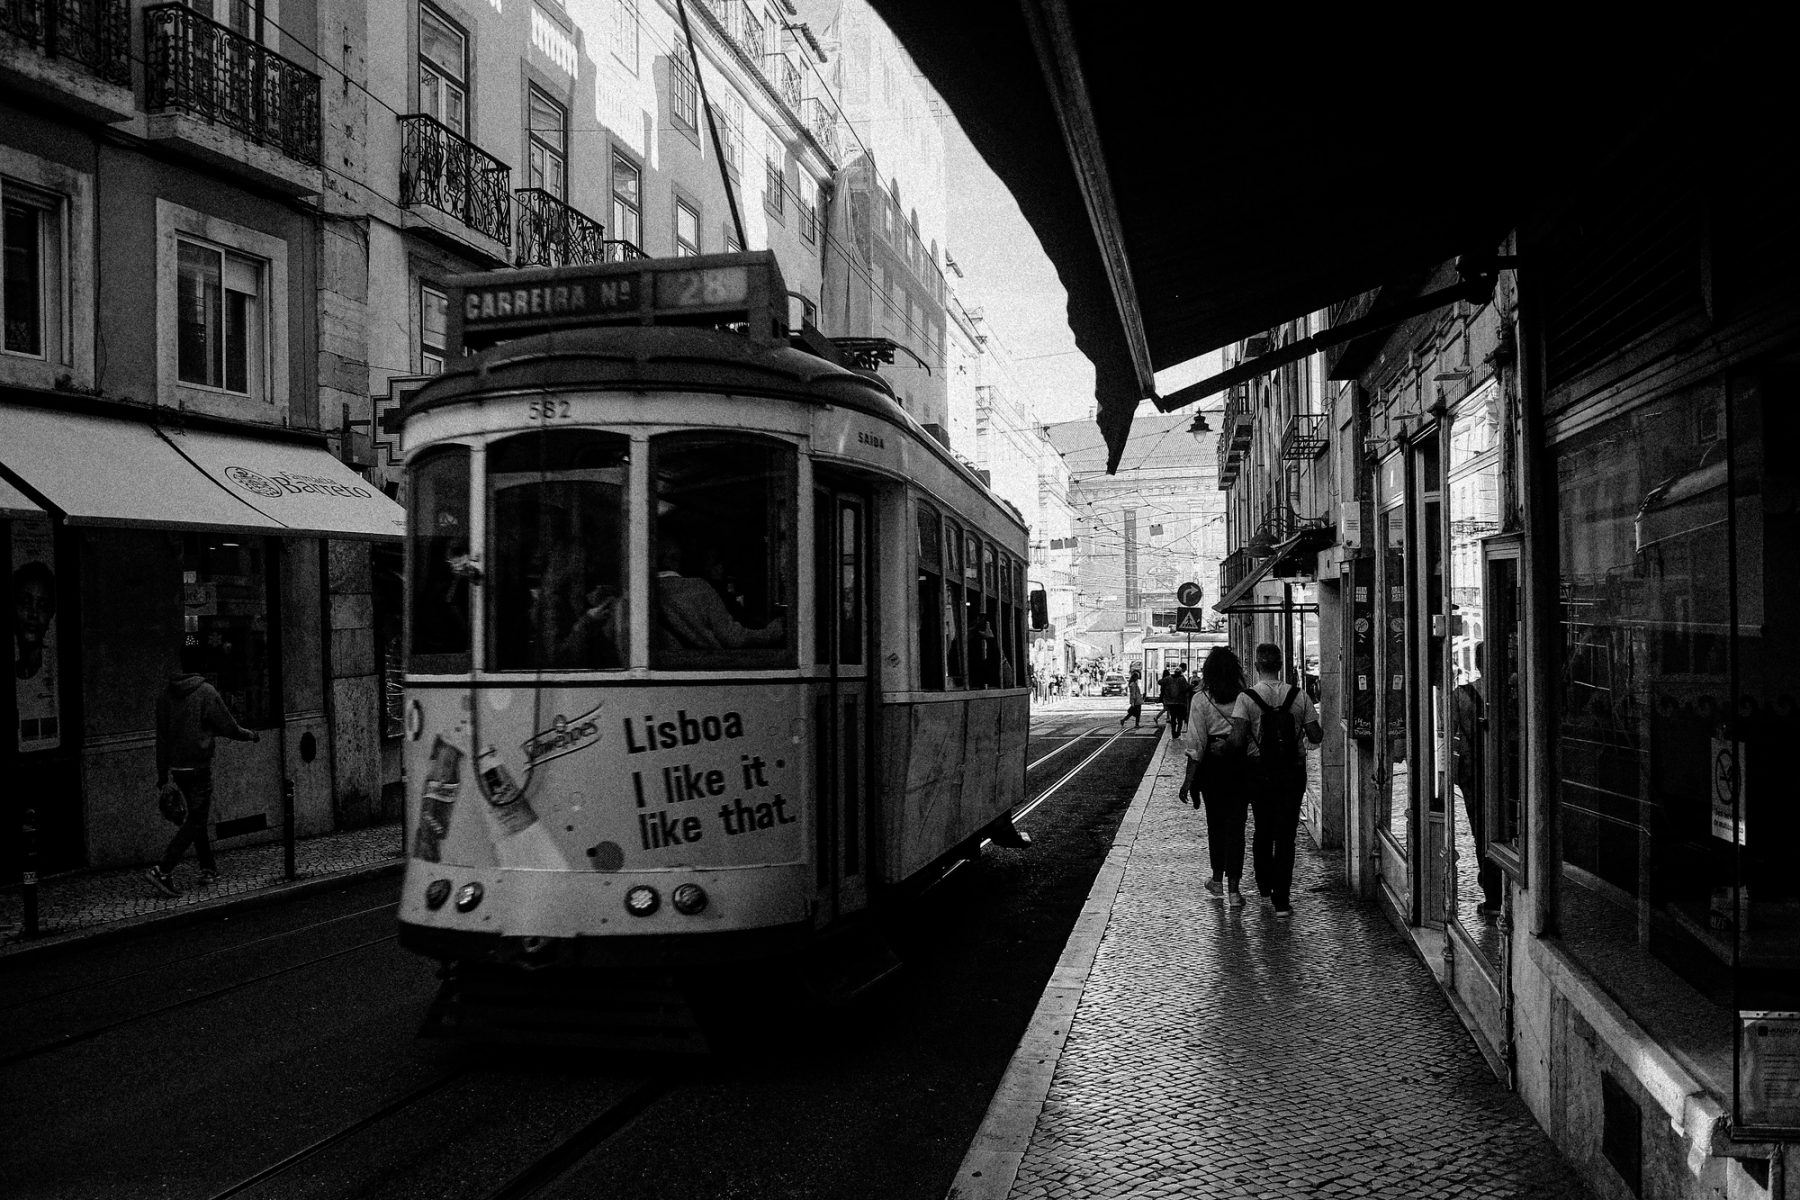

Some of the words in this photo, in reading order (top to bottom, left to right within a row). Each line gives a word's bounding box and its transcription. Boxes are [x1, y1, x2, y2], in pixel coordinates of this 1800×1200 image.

[465, 285, 586, 320] CARREIRA
[678, 270, 726, 306] 28
[271, 477, 372, 498] Barreto
[625, 709, 744, 754] Lisboa
[633, 771, 645, 808] I
[664, 762, 726, 804] like
[639, 811, 702, 850] like
[719, 794, 796, 836] that.
